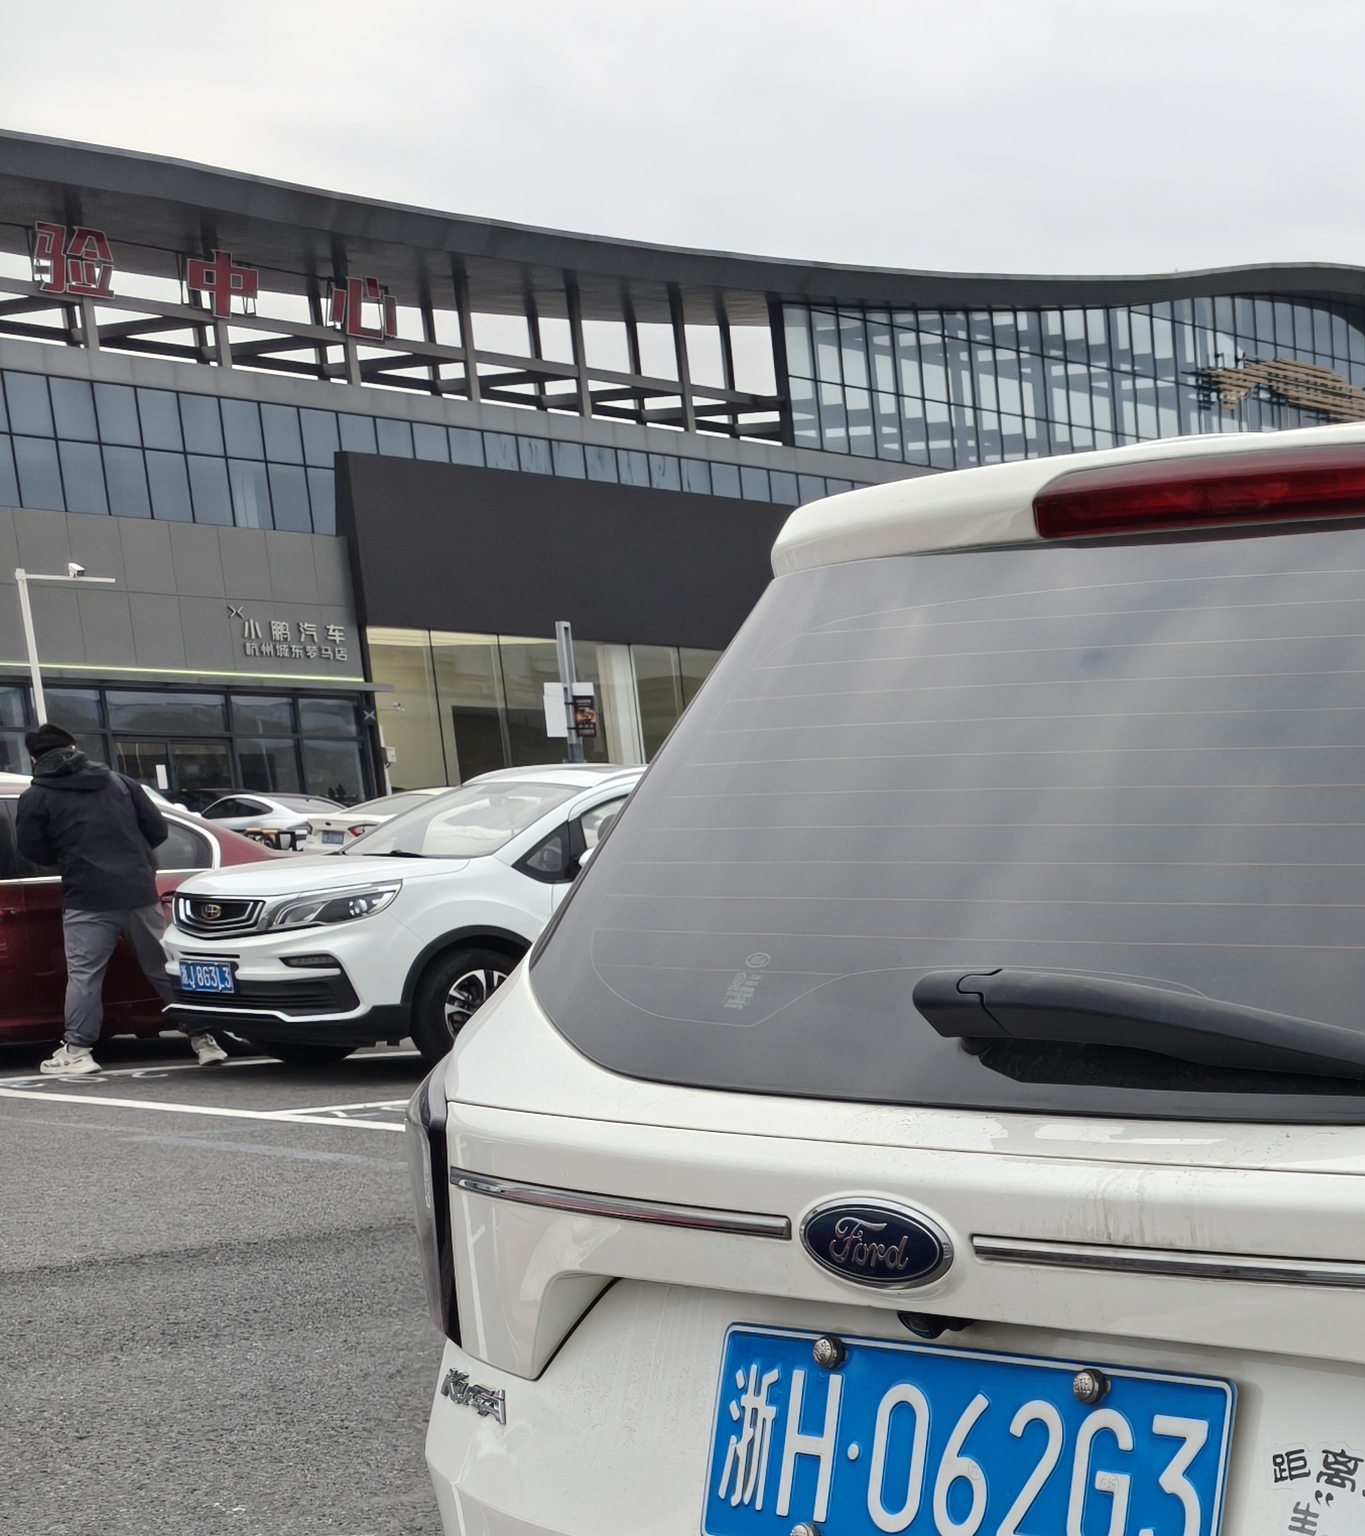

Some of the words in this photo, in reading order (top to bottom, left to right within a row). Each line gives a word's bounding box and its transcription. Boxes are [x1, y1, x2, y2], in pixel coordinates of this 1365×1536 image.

[34, 221, 397, 341] 验中心
[244, 619, 346, 644] 小鹏汽车
[829, 1217, 909, 1271] Ford
